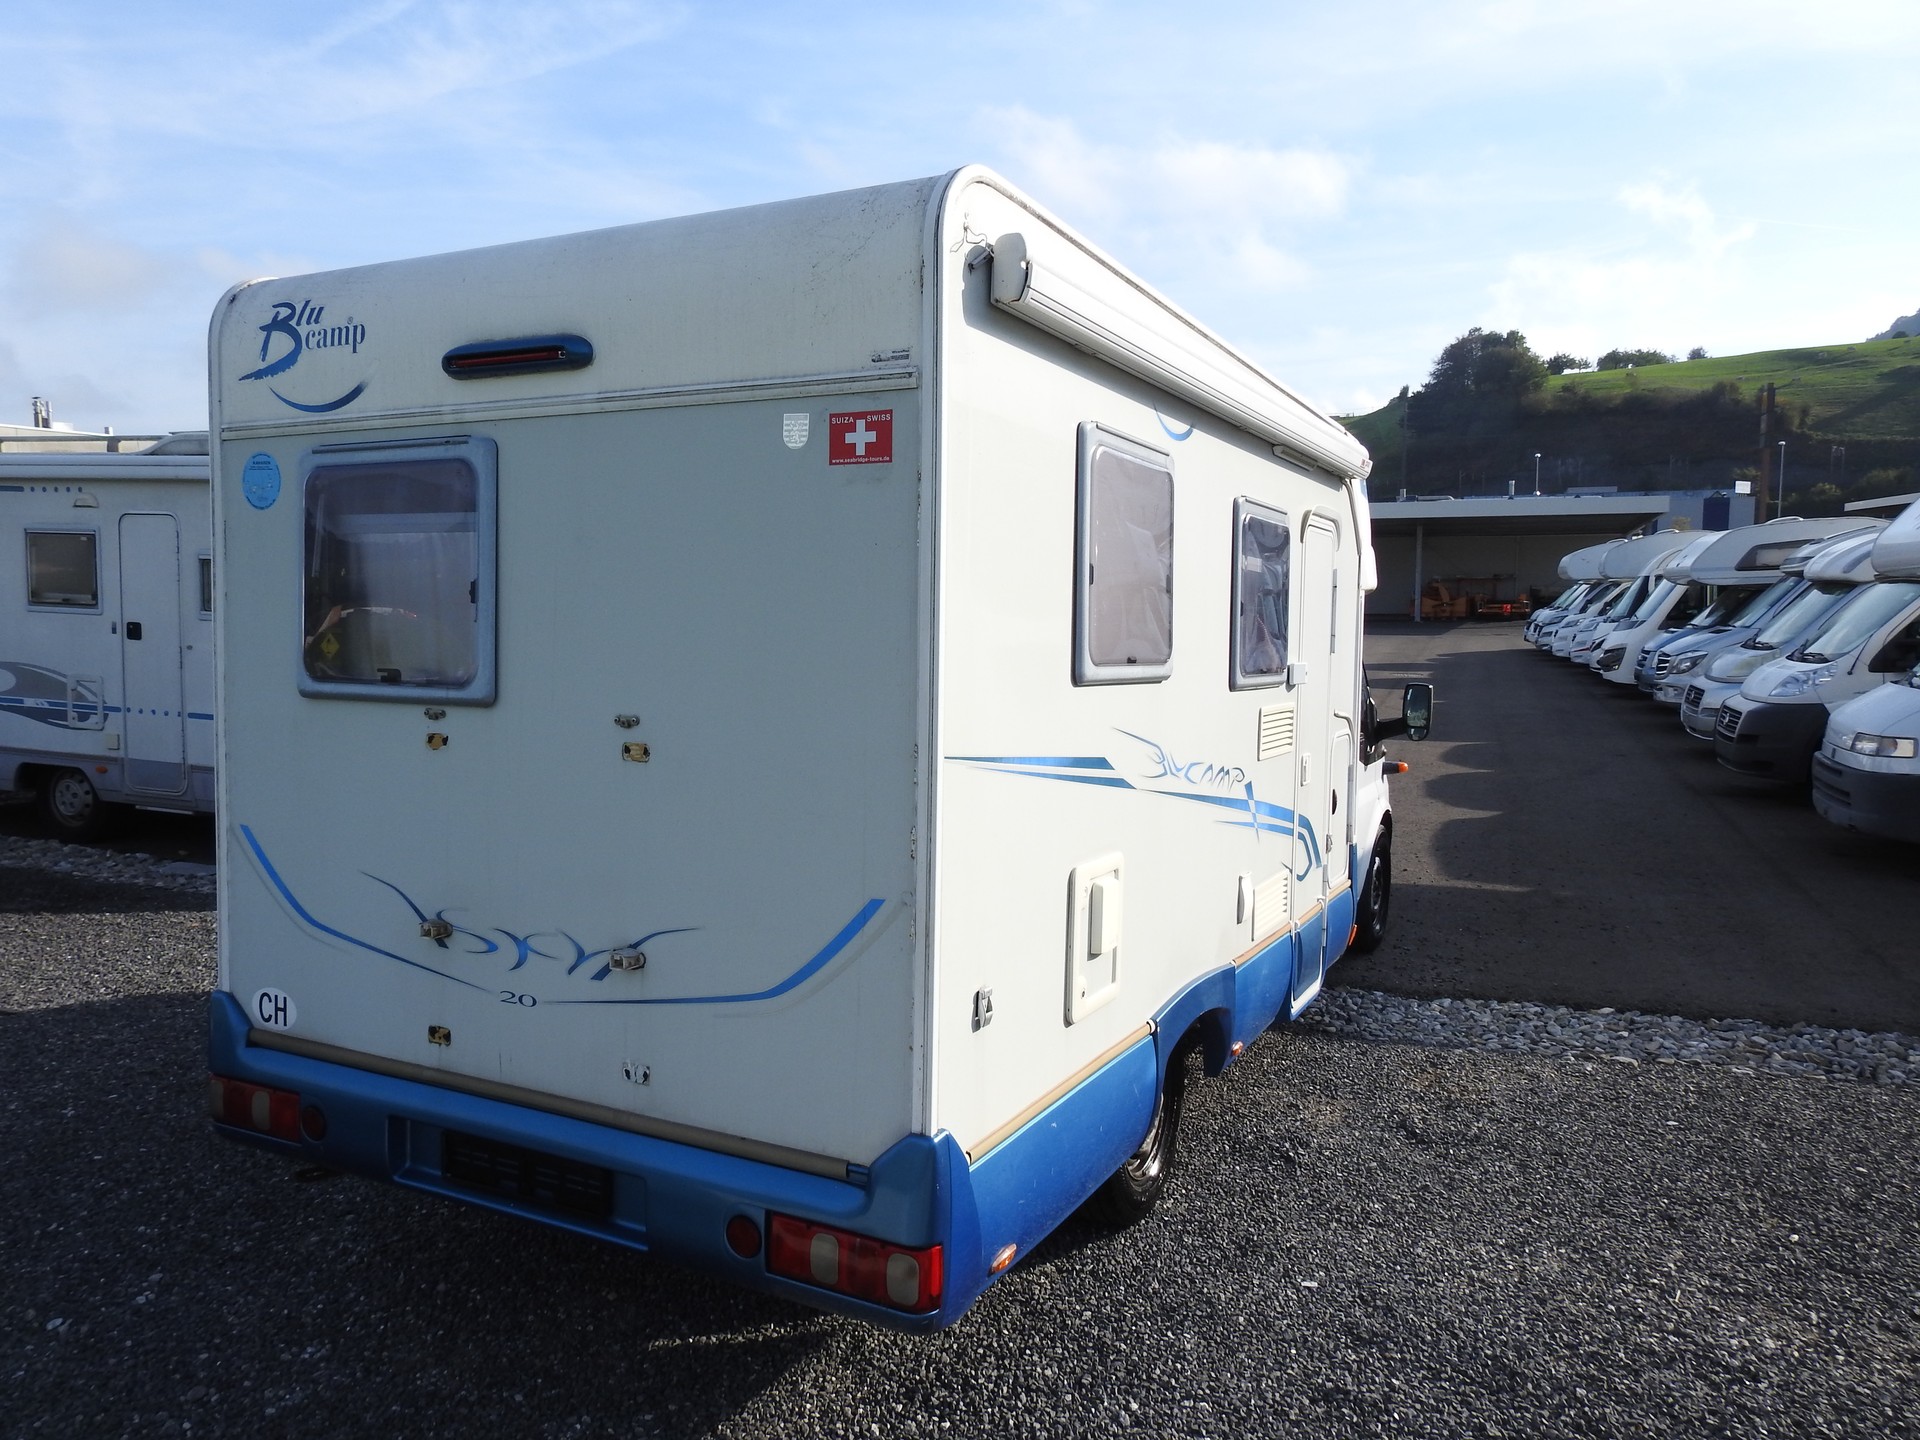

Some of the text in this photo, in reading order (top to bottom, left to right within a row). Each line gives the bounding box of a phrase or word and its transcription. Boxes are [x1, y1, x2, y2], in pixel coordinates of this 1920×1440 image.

[238, 299, 325, 381] Blu
[305, 322, 366, 354] camp
[831, 413, 891, 424] SUIZA SWISS
[258, 991, 288, 1027] CH
[500, 990, 537, 1008] 20
